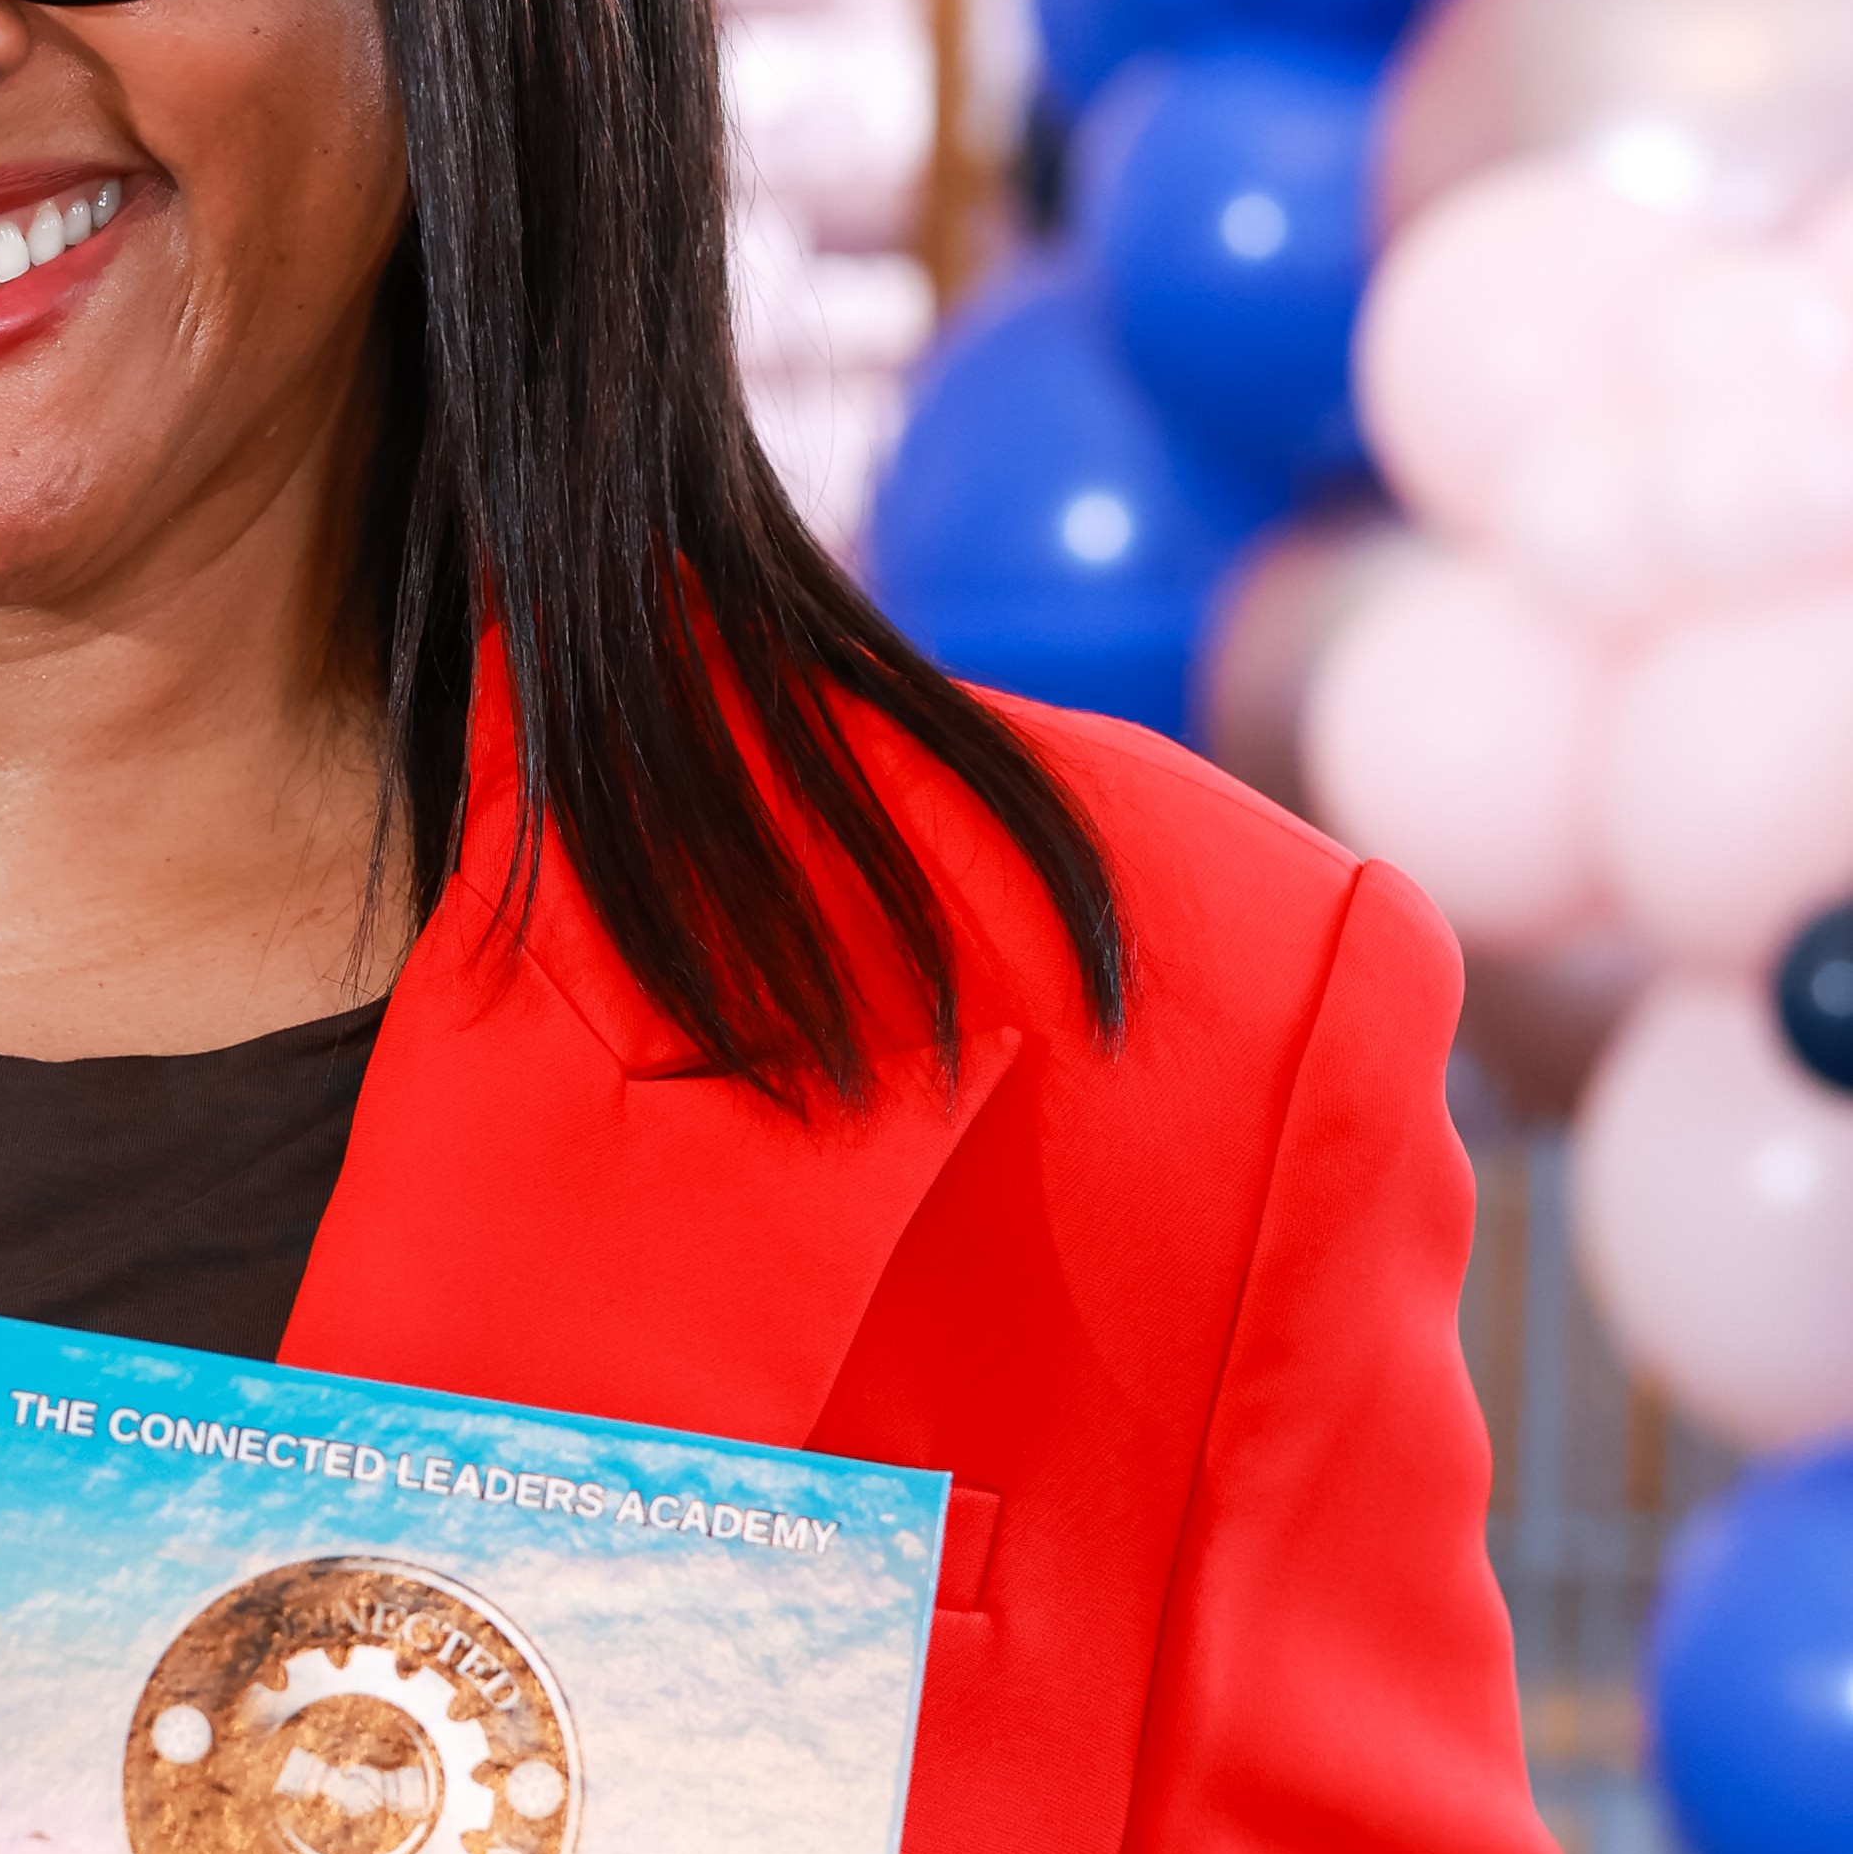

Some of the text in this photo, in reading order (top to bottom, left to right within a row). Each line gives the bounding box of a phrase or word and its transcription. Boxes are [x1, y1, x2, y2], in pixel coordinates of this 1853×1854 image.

[10, 1390, 841, 1554] THE CONNECTED LEADERS ACADEMY
